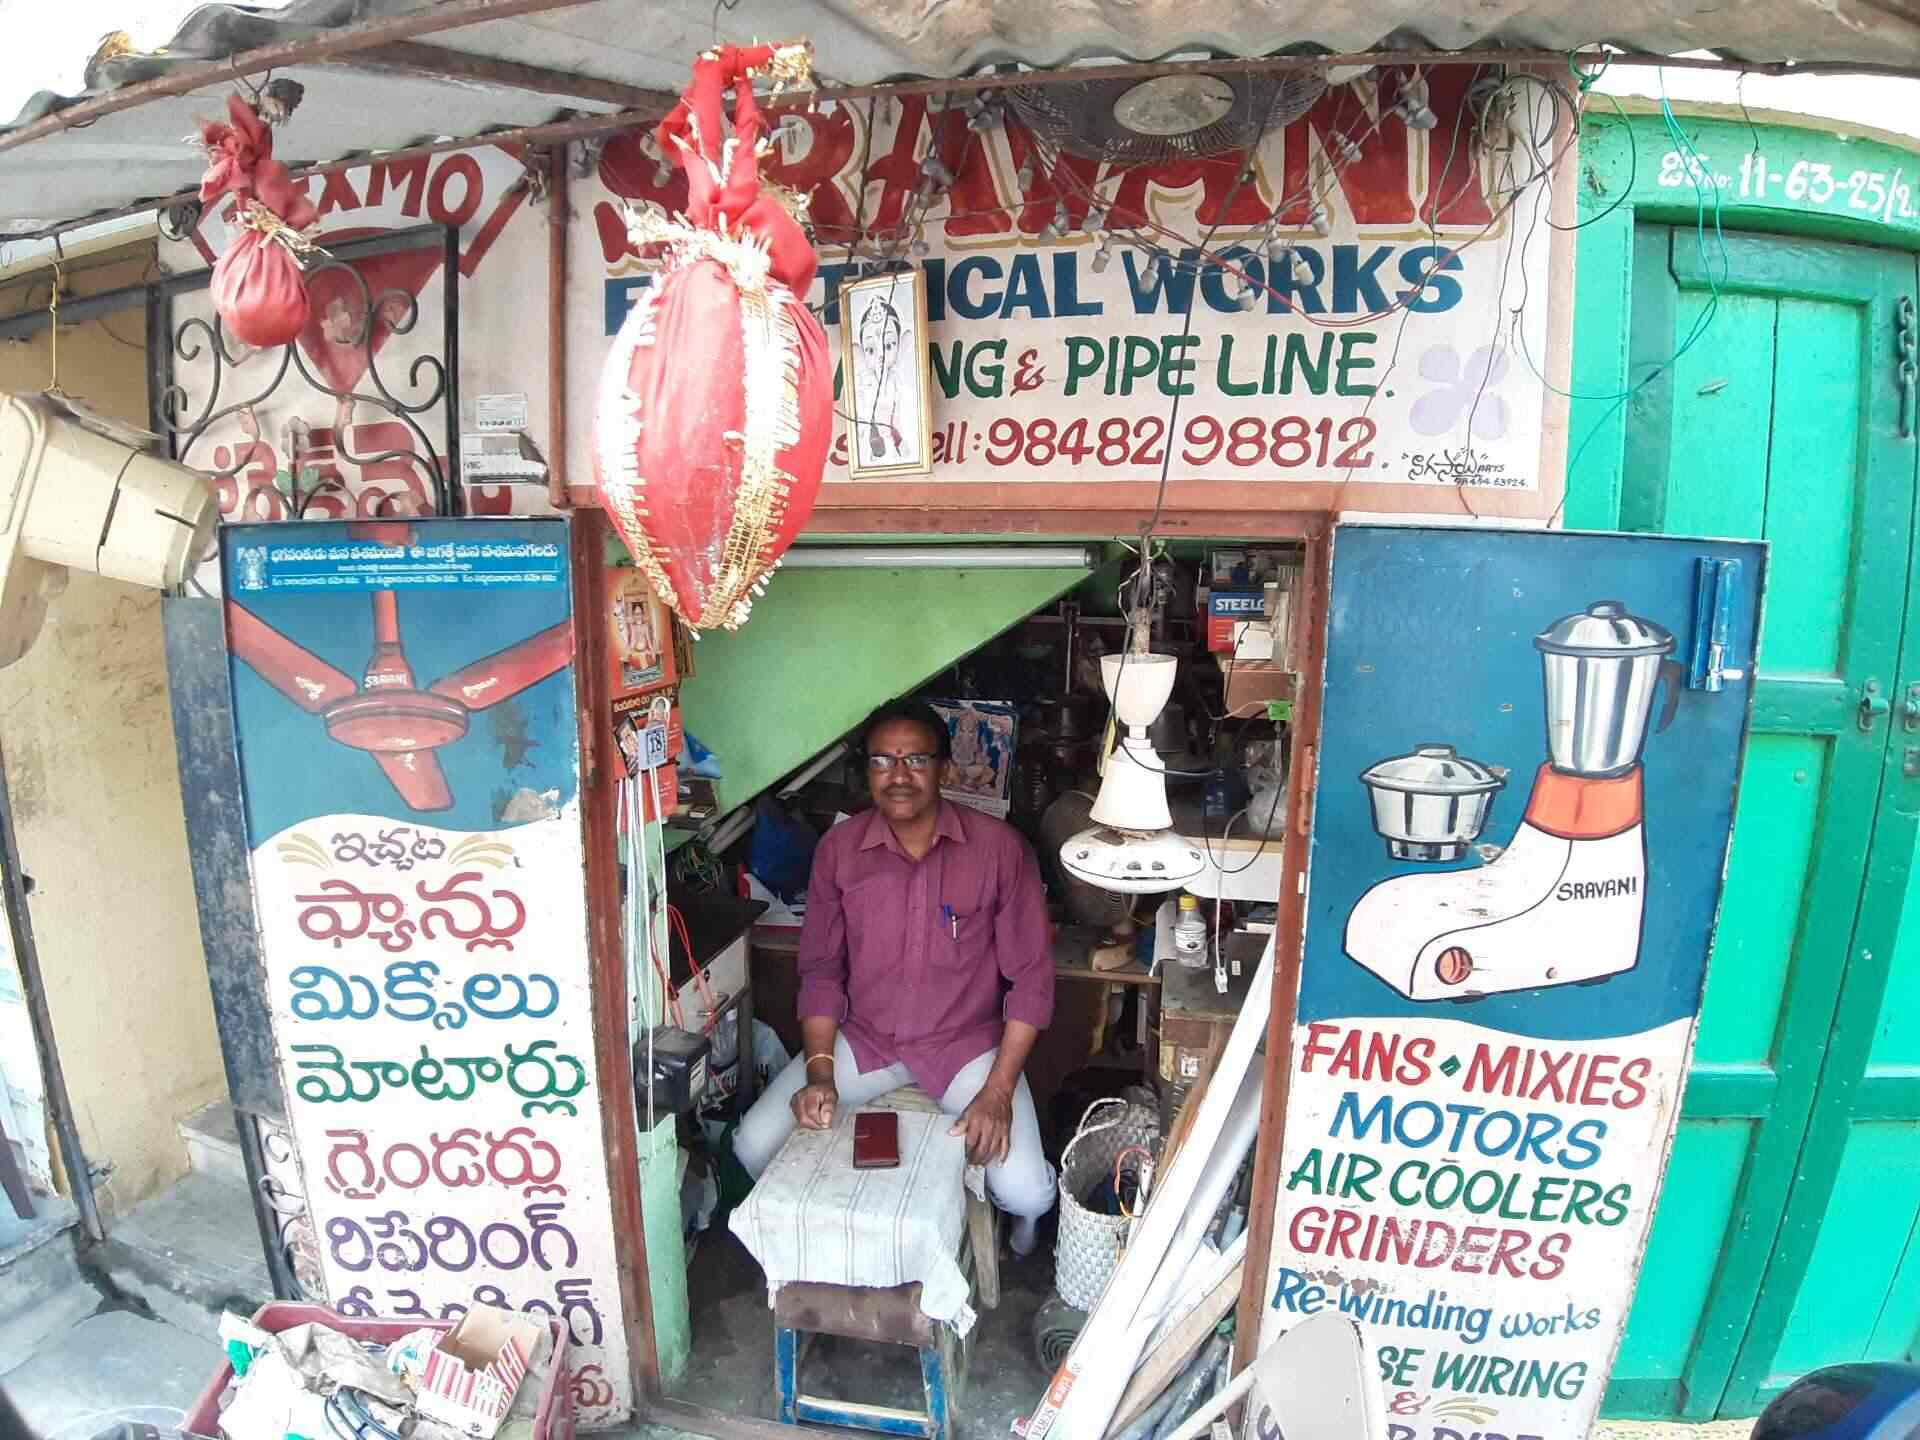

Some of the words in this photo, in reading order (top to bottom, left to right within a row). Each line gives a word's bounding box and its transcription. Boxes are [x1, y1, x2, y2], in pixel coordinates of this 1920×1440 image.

[1122, 245, 1464, 315] WORKS
[1010, 348, 1048, 396] &
[1064, 334, 1201, 397] PIPE
[331, 828, 447, 871] ఇచ్చట
[295, 872, 527, 953] ఫ్యాన్లు
[1557, 877, 1637, 902] SRAVANI
[290, 1040, 588, 1118] మోటార్లు
[1300, 1023, 1436, 1086] FANS
[1462, 1043, 1653, 1110] MIXIES
[1328, 1091, 1608, 1170] MOTORS
[1286, 1148, 1382, 1201] AIR
[1389, 1158, 1632, 1227] COOLERS
[1289, 1206, 1572, 1281] GRINDERS
[1431, 1351, 1588, 1401] WIRING
